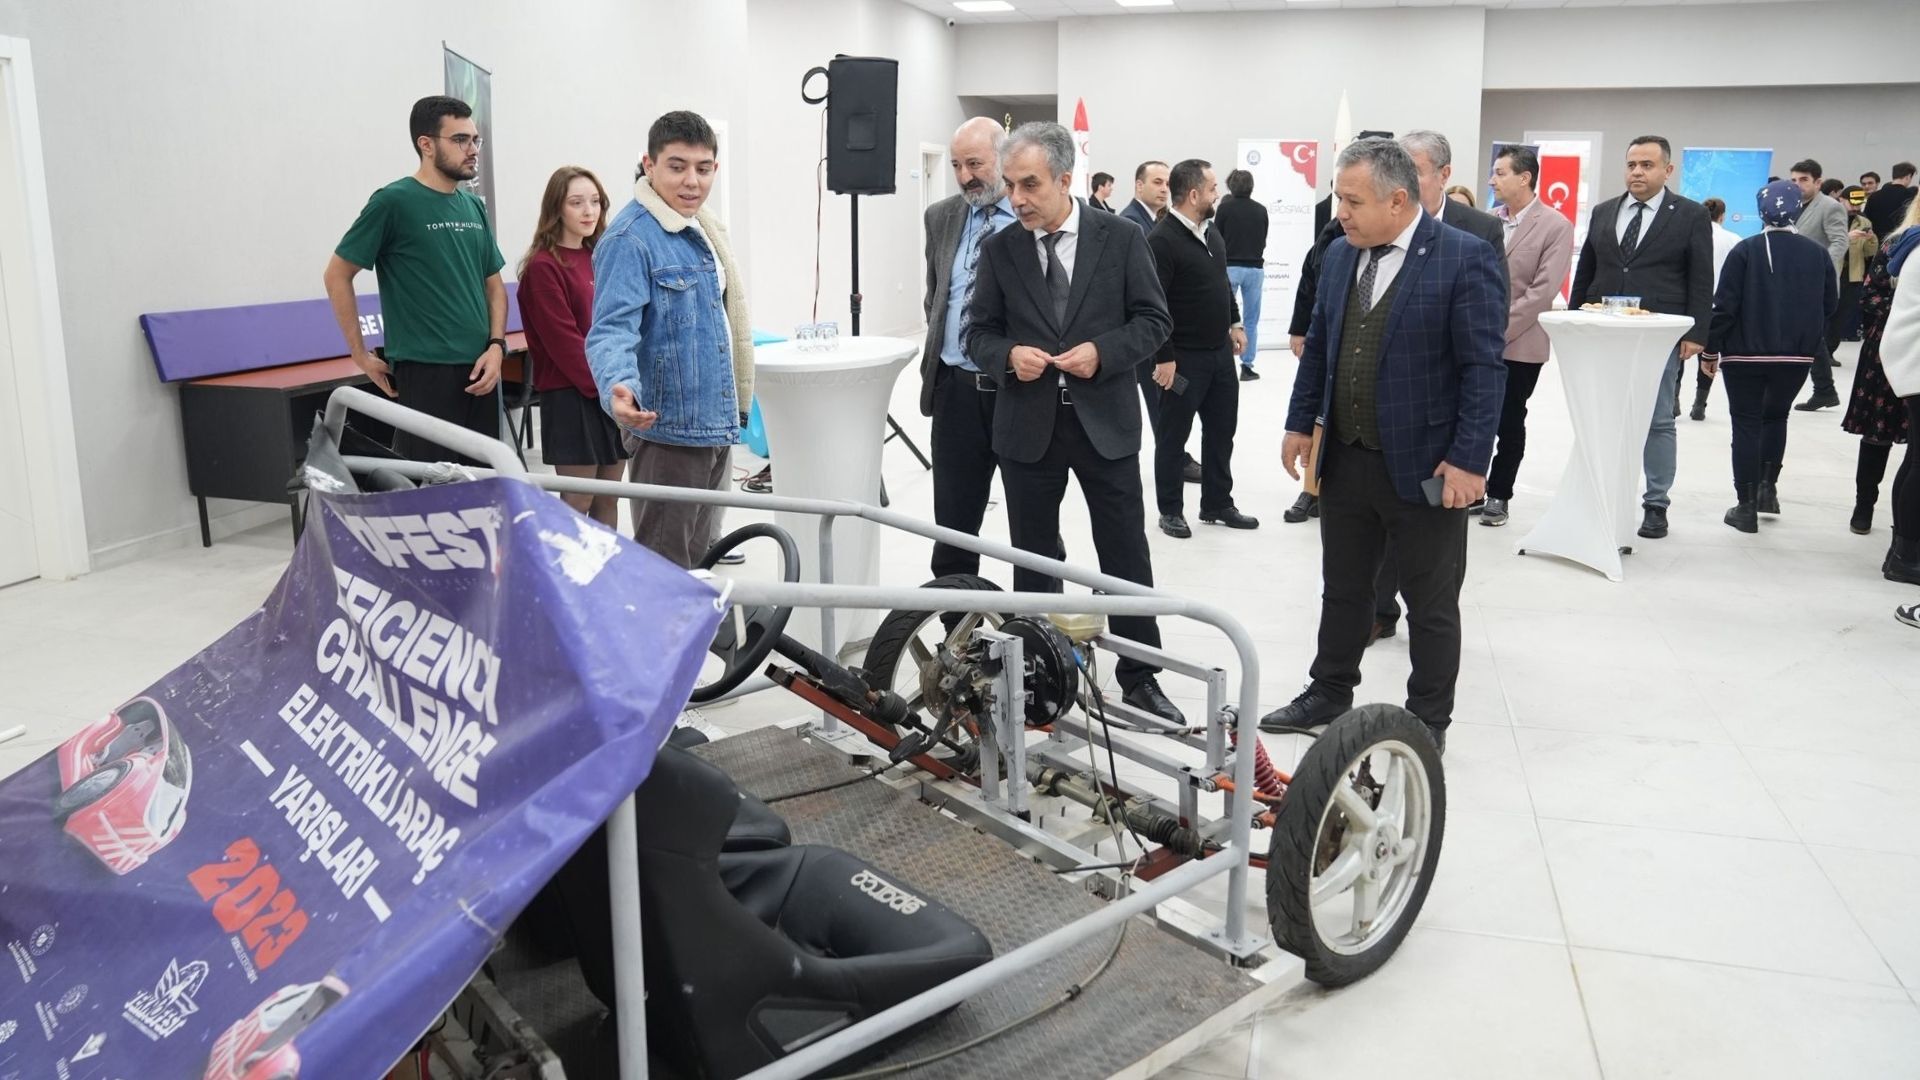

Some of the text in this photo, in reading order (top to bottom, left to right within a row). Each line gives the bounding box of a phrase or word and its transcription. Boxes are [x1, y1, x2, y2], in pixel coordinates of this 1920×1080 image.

[426, 221, 454, 230] TOMMY
[316, 617, 498, 808] CHALLENGE
[268, 764, 381, 900] YARIŞLARI
[278, 683, 461, 886] ELEKTRİKLİ ARAÇ
[187, 836, 309, 970] 2023
